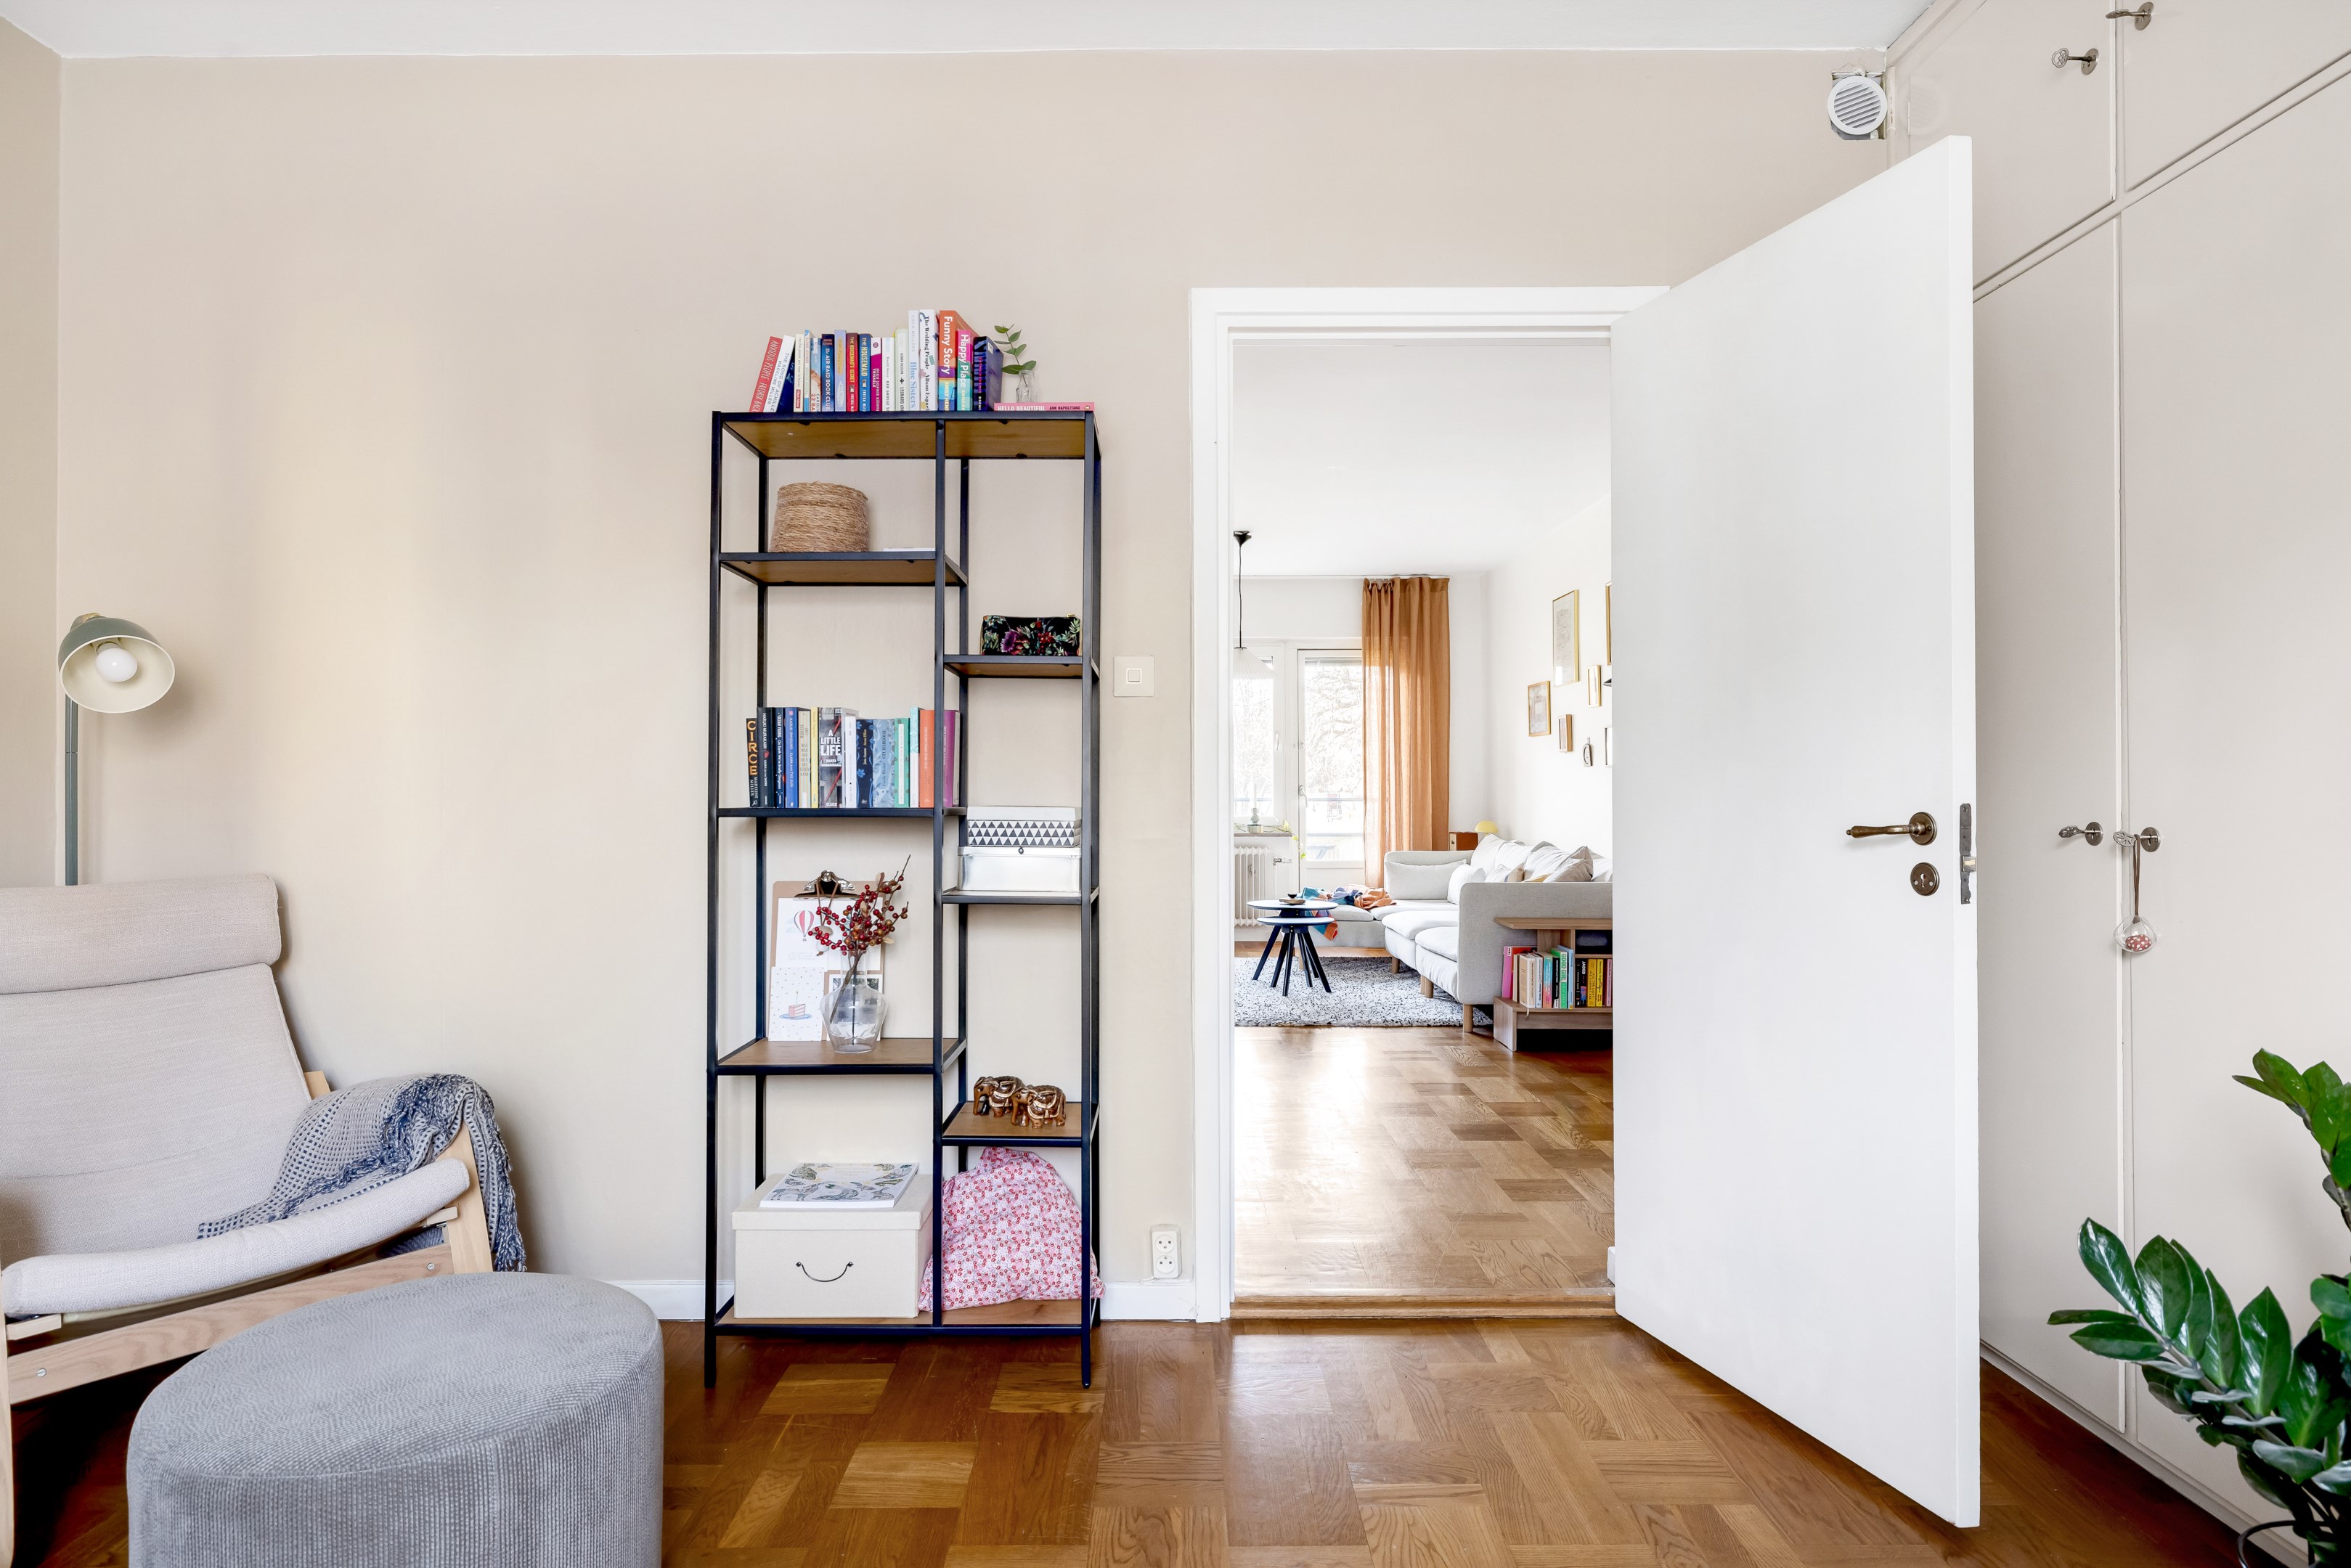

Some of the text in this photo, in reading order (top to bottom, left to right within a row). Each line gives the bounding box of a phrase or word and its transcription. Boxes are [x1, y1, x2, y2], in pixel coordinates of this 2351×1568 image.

[941, 316, 953, 375] Funny Story
[761, 340, 779, 380] ANXIOUS PEOPLE
[959, 334, 969, 388] Happy Place
[773, 361, 782, 385] MADELINE
[755, 383, 767, 400] FREDRIK
[770, 389, 780, 411] ACHILLE
[811, 403, 815, 411] BA
[747, 720, 758, 775] CIRCE
[821, 745, 841, 756] LIFE
